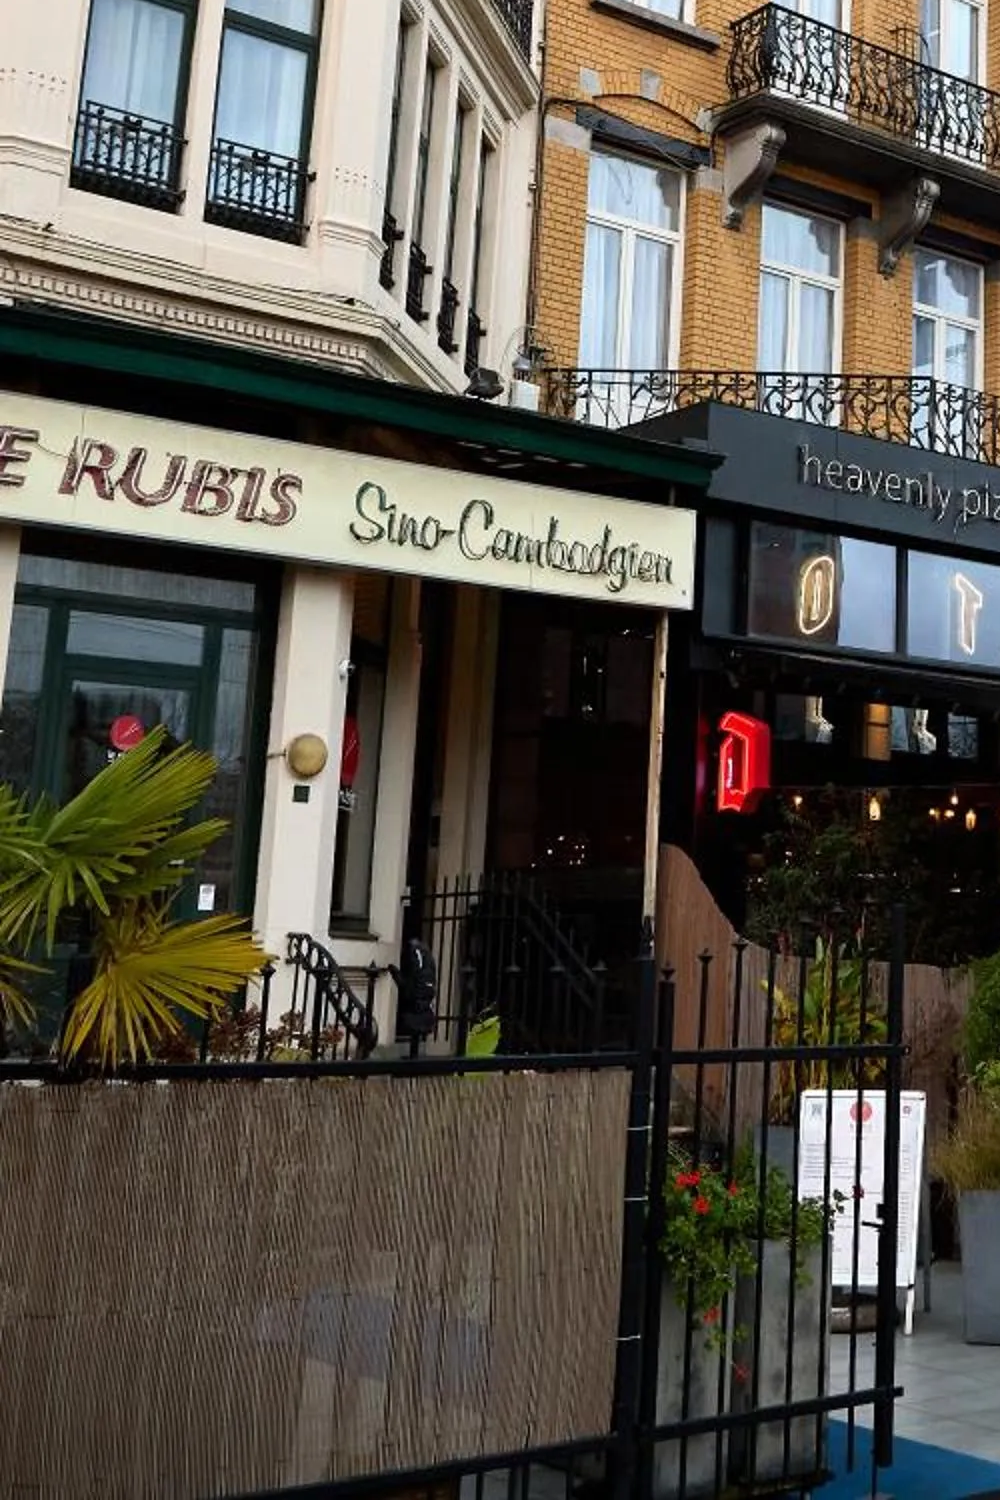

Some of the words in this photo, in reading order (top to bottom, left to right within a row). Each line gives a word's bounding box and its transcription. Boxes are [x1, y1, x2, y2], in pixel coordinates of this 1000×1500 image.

[57, 436, 303, 526] RUBIS
[798, 443, 951, 525] heavenly
[349, 481, 674, 593] Sino-Cambodgien
